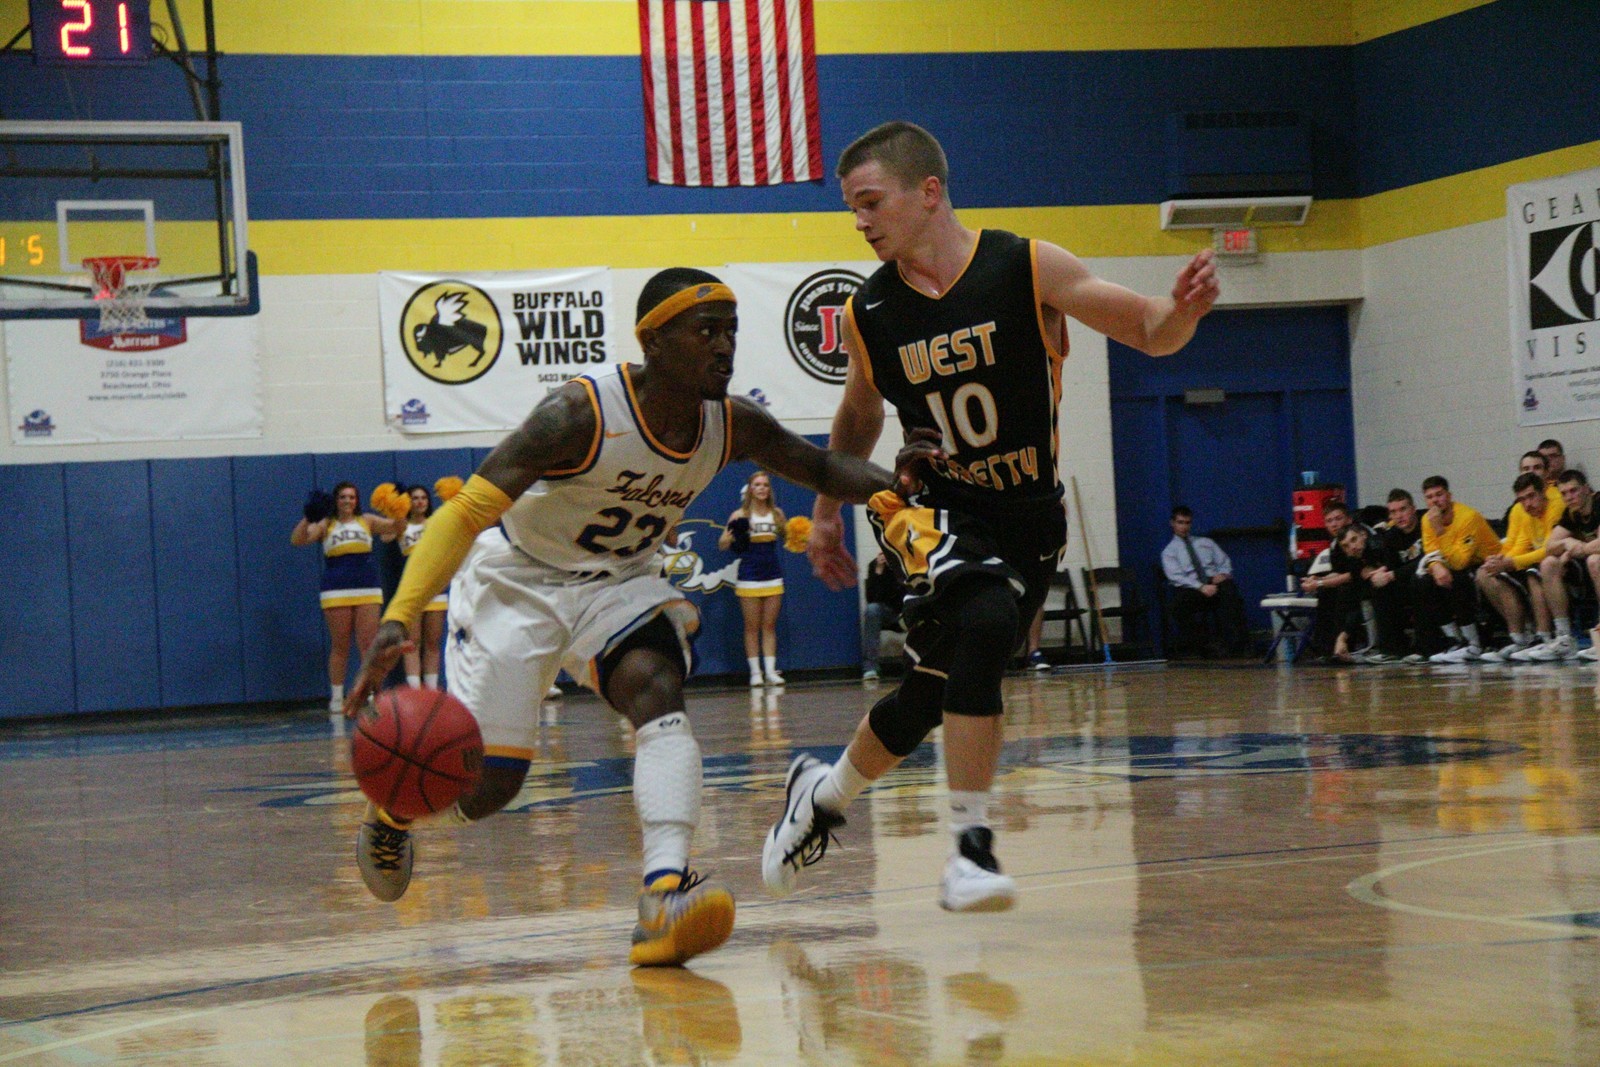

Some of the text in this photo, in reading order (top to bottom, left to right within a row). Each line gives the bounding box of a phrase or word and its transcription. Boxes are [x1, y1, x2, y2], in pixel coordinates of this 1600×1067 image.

[61, 0, 130, 57] 21
[1224, 230, 1249, 251] EXIT
[512, 290, 604, 310] BUFFALO
[799, 282, 836, 312] JIMMY
[513, 309, 605, 340] WILD
[515, 340, 607, 366] WINGS
[799, 342, 835, 374] GOURMET
[898, 321, 997, 385] WEST
[925, 382, 999, 456] 10
[604, 470, 694, 508] Falcons
[575, 506, 667, 556] 23
